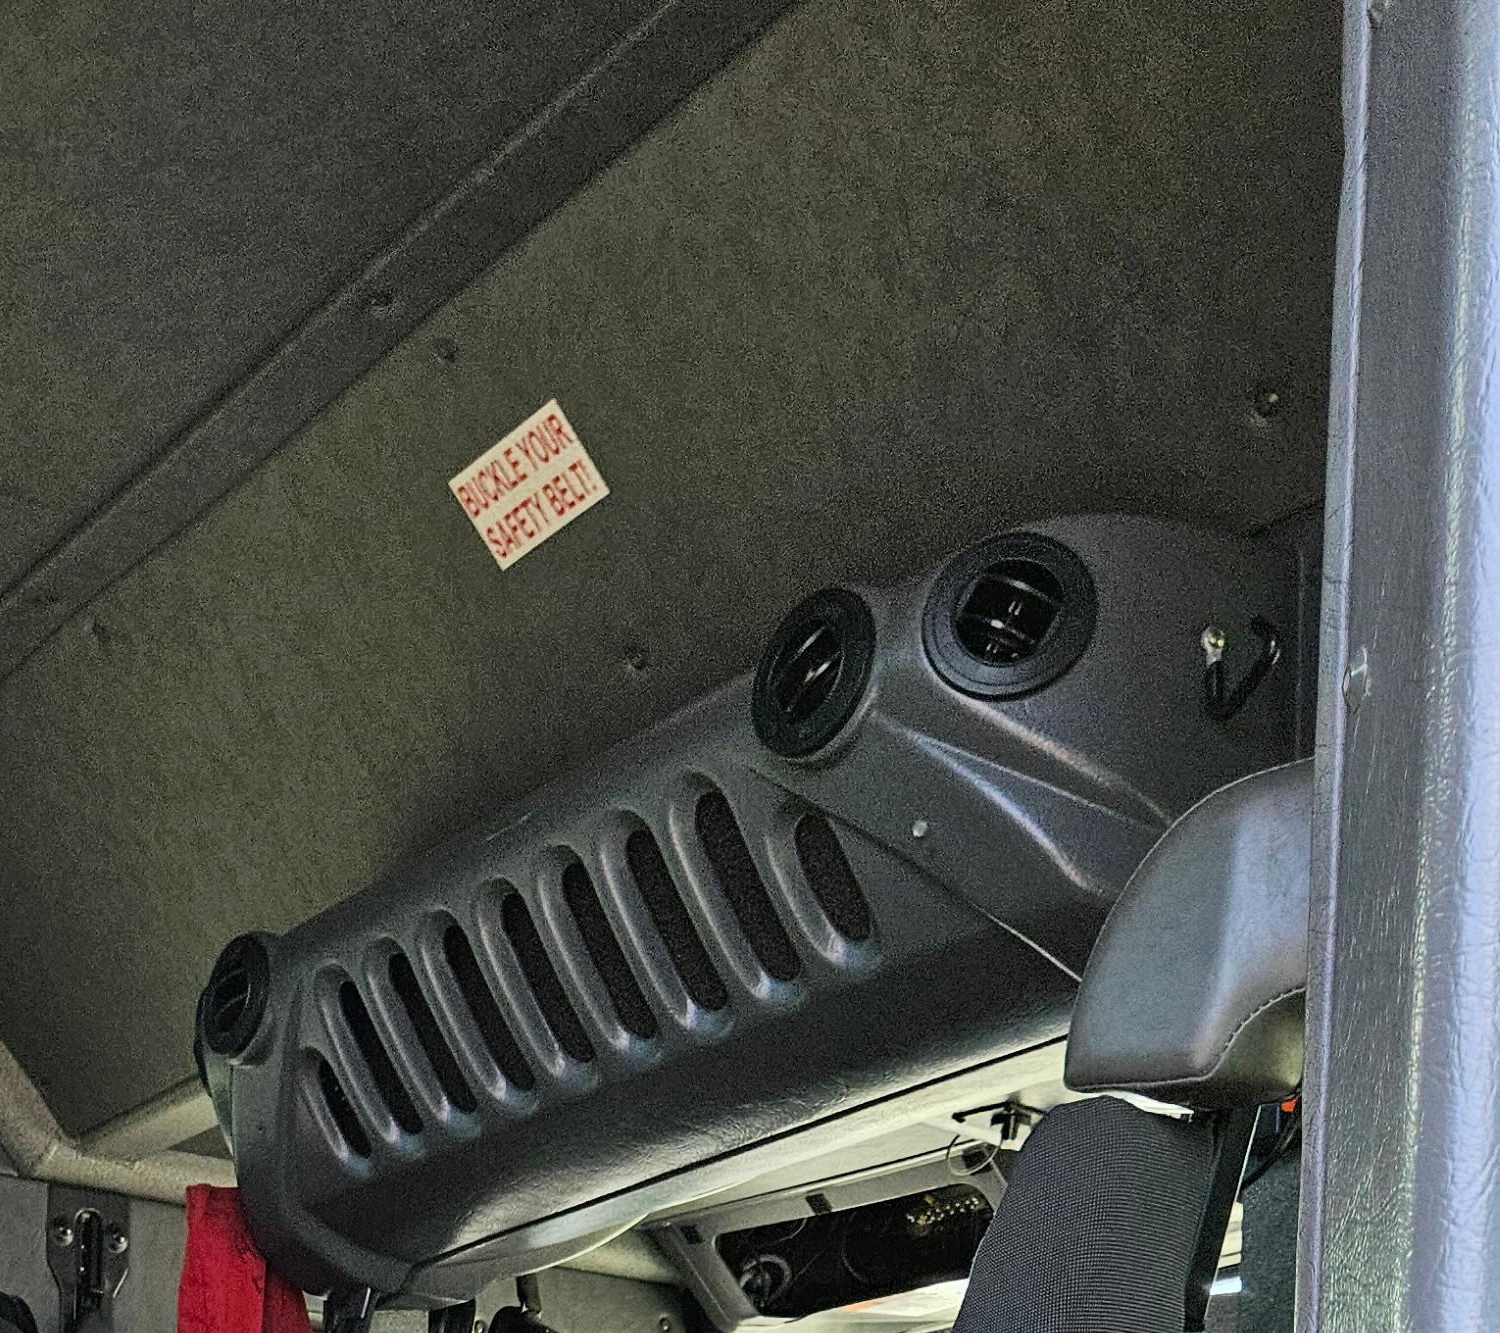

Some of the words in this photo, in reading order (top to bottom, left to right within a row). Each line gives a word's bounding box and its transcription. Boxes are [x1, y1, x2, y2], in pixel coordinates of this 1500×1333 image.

[457, 447, 529, 519] BUCKLE
[515, 413, 574, 471] YOUR
[485, 492, 550, 559] SAFETY
